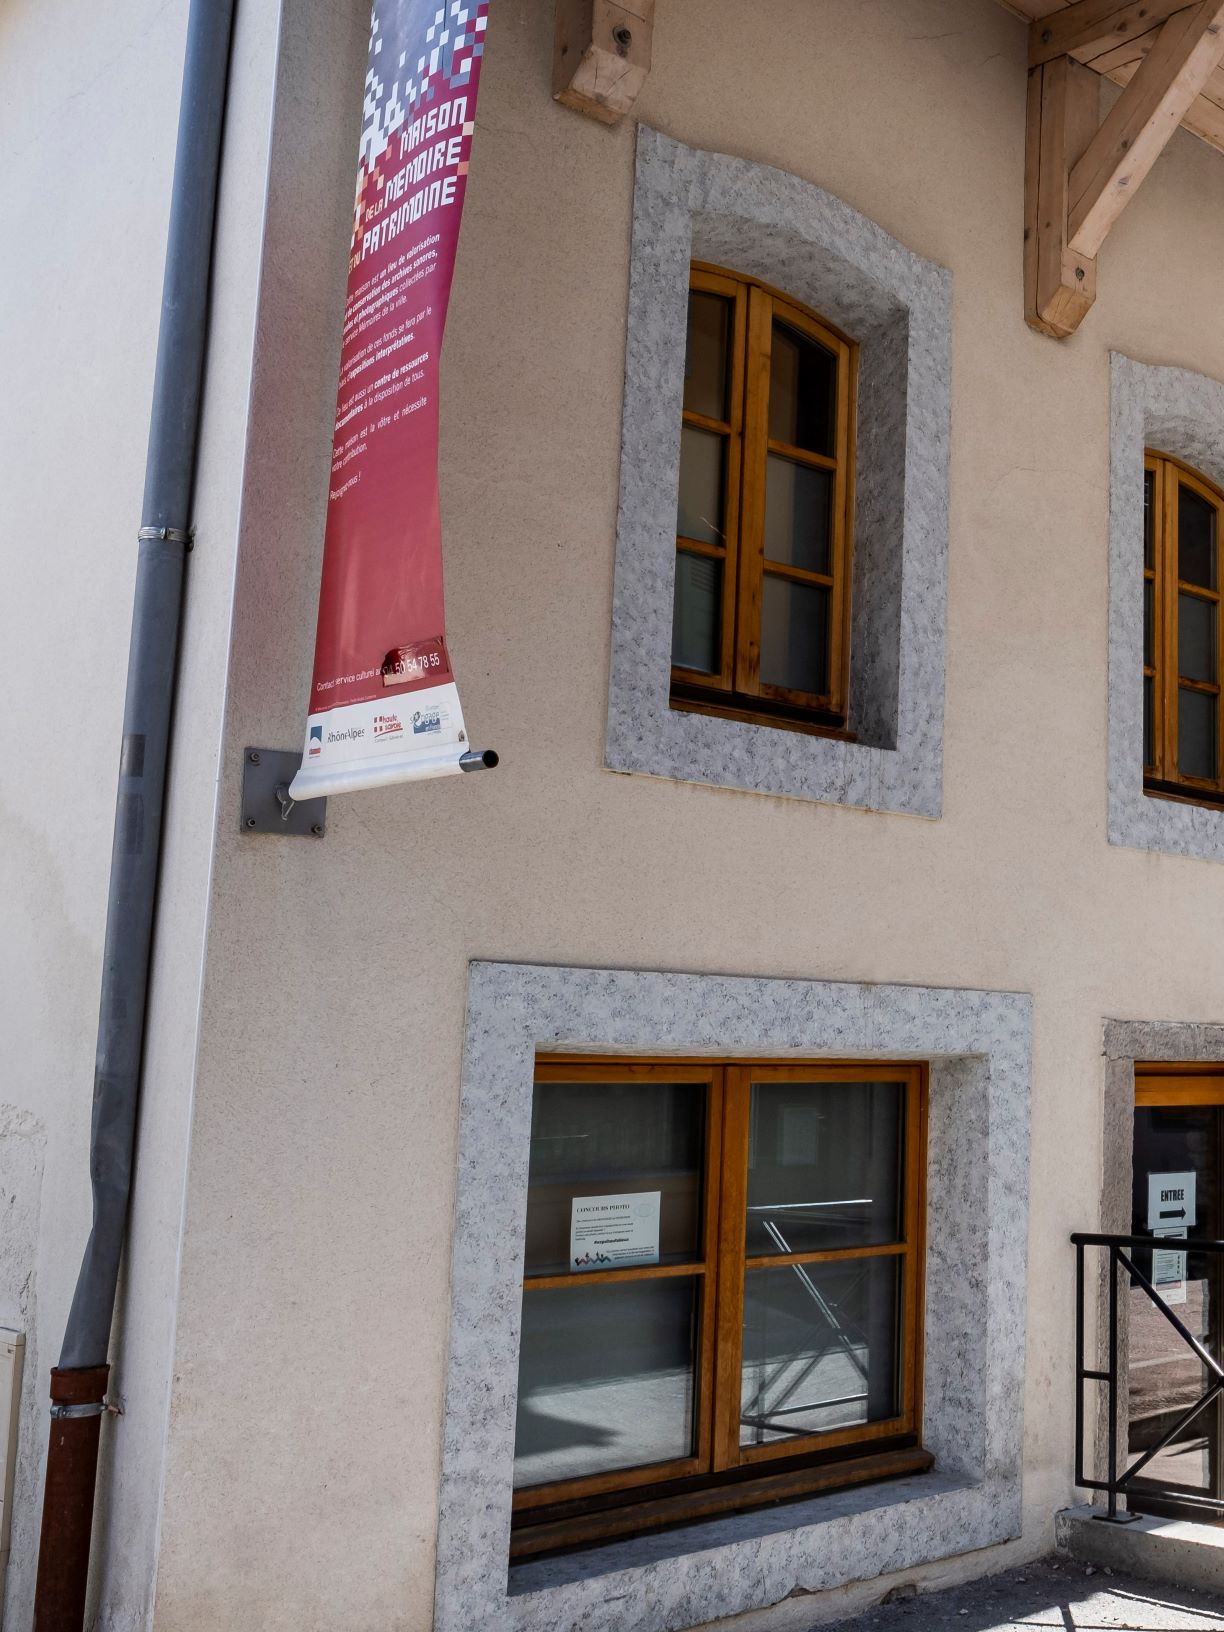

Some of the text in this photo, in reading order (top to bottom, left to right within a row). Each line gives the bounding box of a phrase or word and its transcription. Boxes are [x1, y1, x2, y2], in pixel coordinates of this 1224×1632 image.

[400, 97, 467, 160] MAISON
[384, 136, 462, 208] MEMOIRE
[362, 176, 457, 260] PATRIMOINE
[353, 286, 380, 312] conservation
[392, 264, 412, 283] archives
[414, 250, 438, 268] sonores,
[371, 274, 379, 285] est
[388, 261, 397, 273] lieu
[406, 234, 440, 259] valorisation
[359, 287, 398, 322] photographiques
[399, 269, 424, 292] collectées
[383, 329, 398, 342] fonds
[374, 373, 391, 389] centre
[400, 352, 429, 374] ressources
[374, 382, 403, 402] disposition
[378, 416, 391, 428] vôtre
[402, 396, 427, 416] nécessite
[316, 682, 334, 692] Contact
[335, 674, 356, 684] service
[356, 668, 374, 680] culturel
[395, 659, 406, 674] 50
[407, 658, 417, 672] 54
[418, 656, 428, 670] 78
[430, 652, 440, 666] 55
[1161, 1189, 1184, 1202] ENTREE
